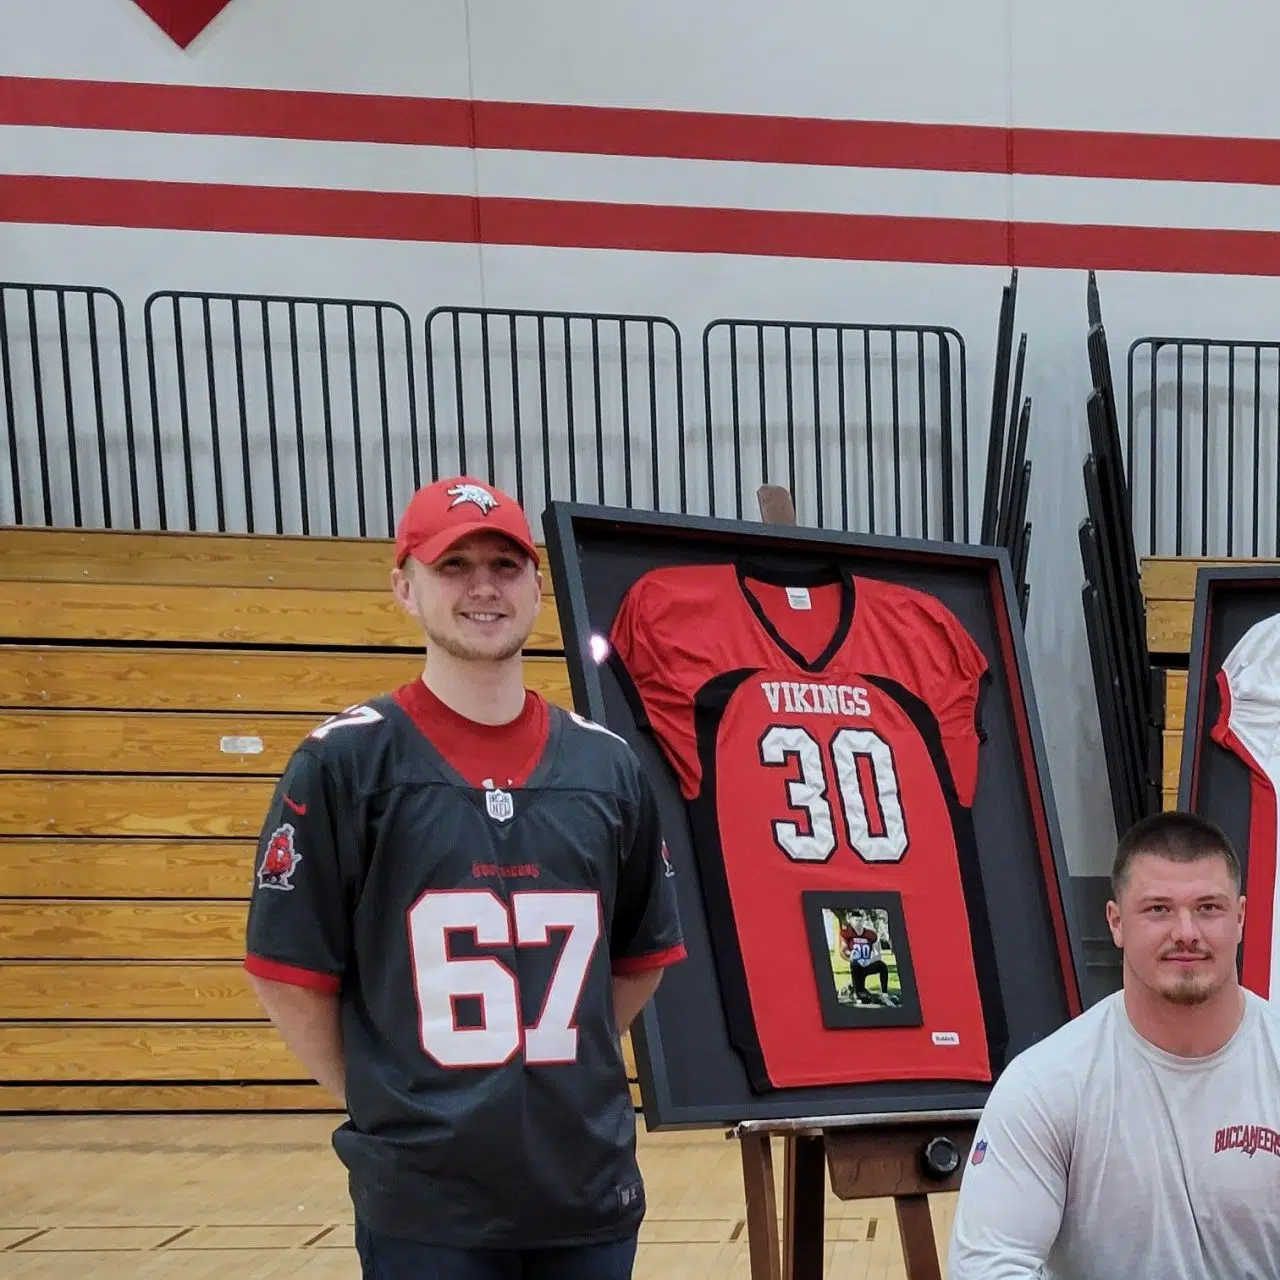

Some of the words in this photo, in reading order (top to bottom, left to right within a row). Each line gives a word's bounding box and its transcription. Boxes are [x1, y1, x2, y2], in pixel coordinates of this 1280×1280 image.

[761, 681, 872, 717] VIKINGS
[757, 723, 911, 865] 30
[404, 888, 602, 1070] 67
